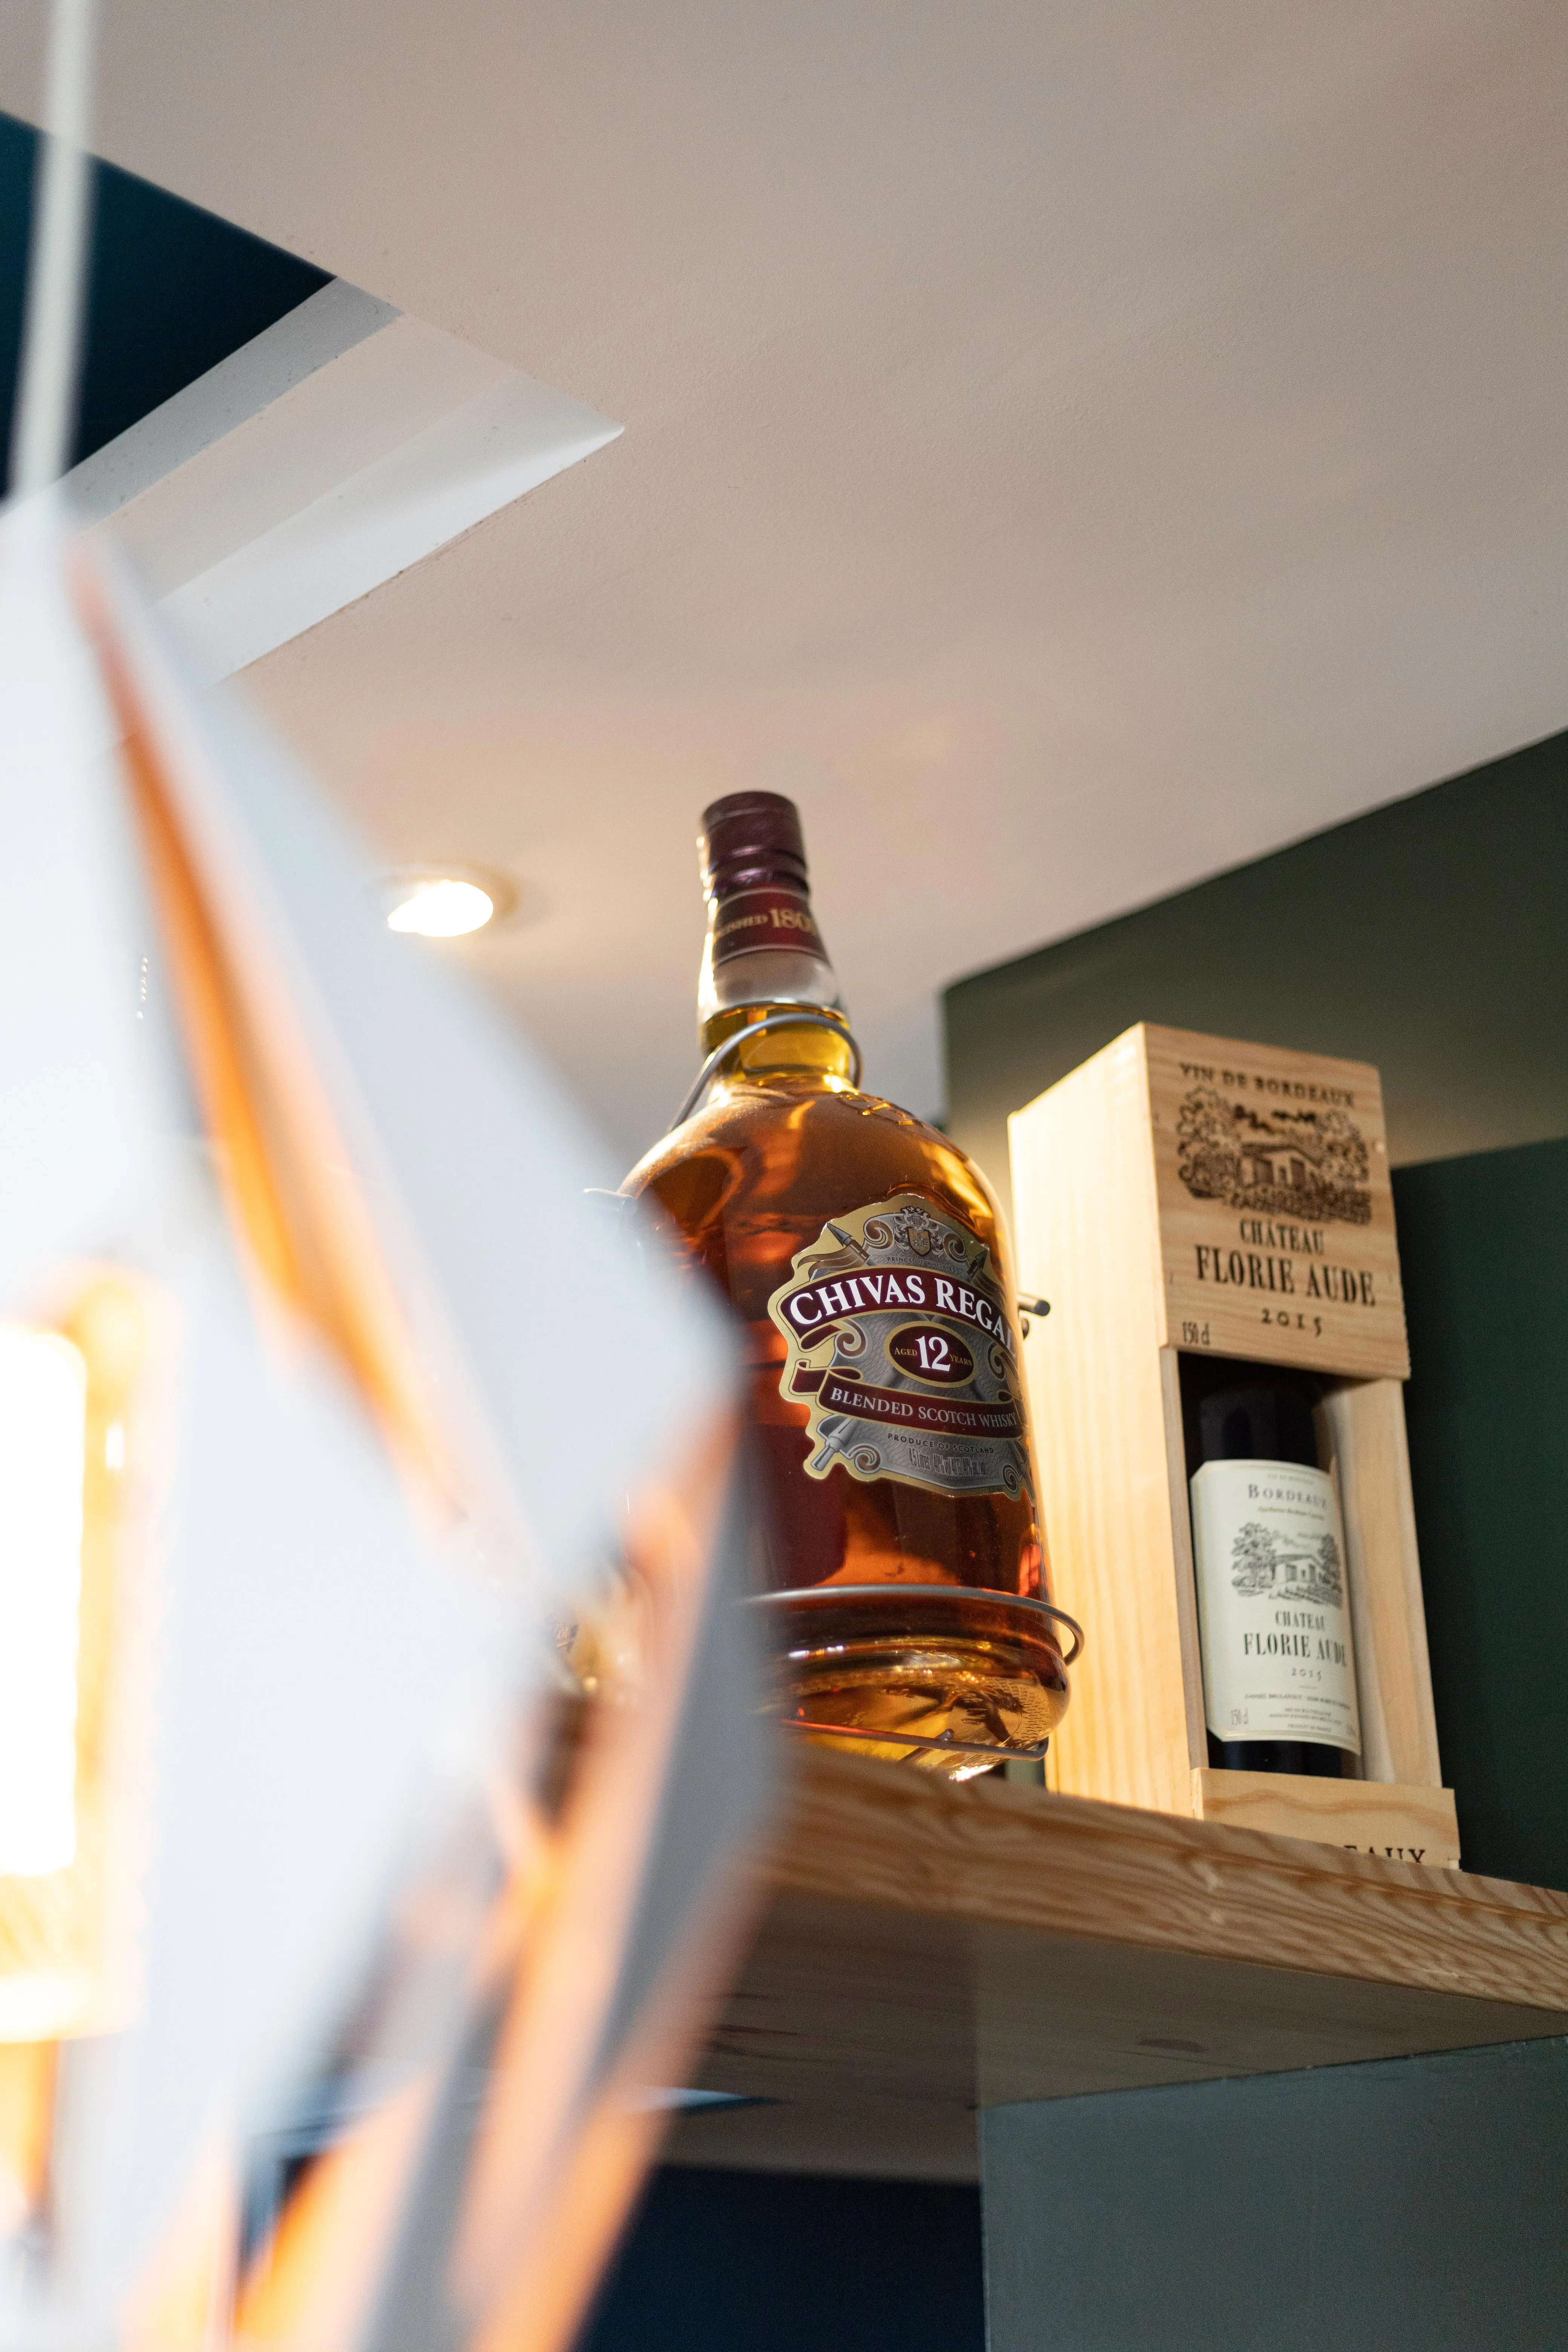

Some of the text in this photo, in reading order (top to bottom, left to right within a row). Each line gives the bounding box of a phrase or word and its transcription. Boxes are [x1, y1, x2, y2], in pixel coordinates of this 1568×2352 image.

[1180, 1062, 1355, 1109] VIN DE BORDEAUX
[925, 1260, 956, 1273] WHISKIES
[1195, 1245, 1376, 1307] FLORIE AUDE
[790, 1274, 925, 1325] CHIVAS
[1261, 1308, 1322, 1337] 2015
[894, 1335, 972, 1372] AGED 12 YEARS
[830, 1387, 1017, 1428] BLENDED SCOTCH WHISKY
[888, 1433, 934, 1448] PRODUCE
[953, 1444, 994, 1453] SCOTLAND
[909, 1447, 917, 1466] 4.5
[917, 1450, 930, 1470] Litres
[1244, 1633, 1311, 1658] FLORIE
[1292, 1668, 1321, 1681] 2015
